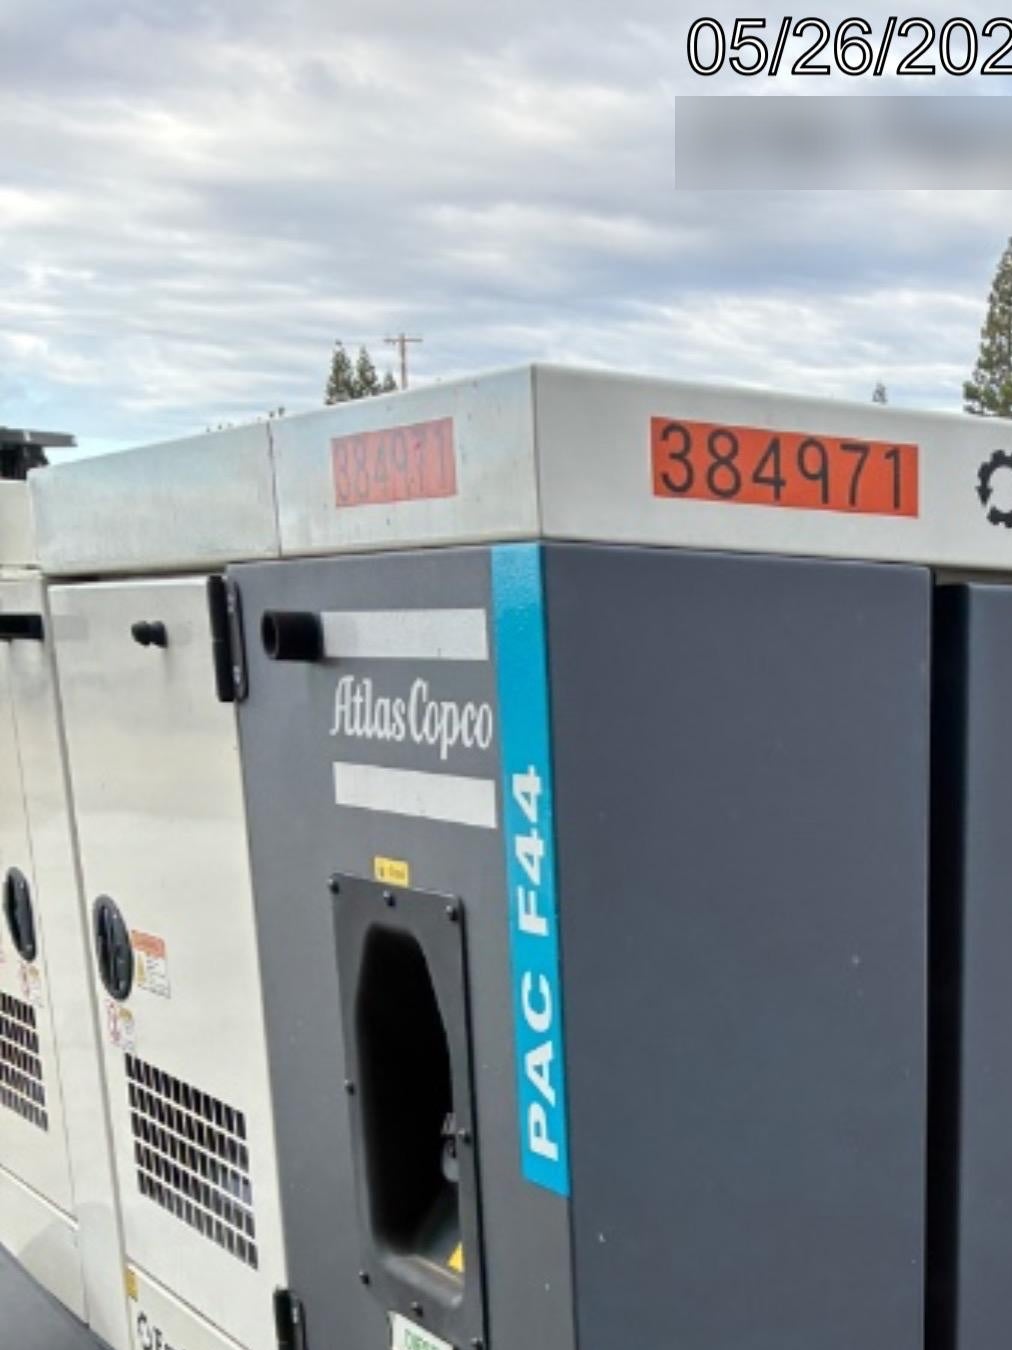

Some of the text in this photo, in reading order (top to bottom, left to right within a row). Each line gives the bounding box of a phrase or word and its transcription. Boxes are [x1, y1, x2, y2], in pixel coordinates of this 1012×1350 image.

[660, 423, 901, 509] 384971
[329, 674, 493, 760] Atlas Copco
[511, 765, 560, 1162] PAC F44
